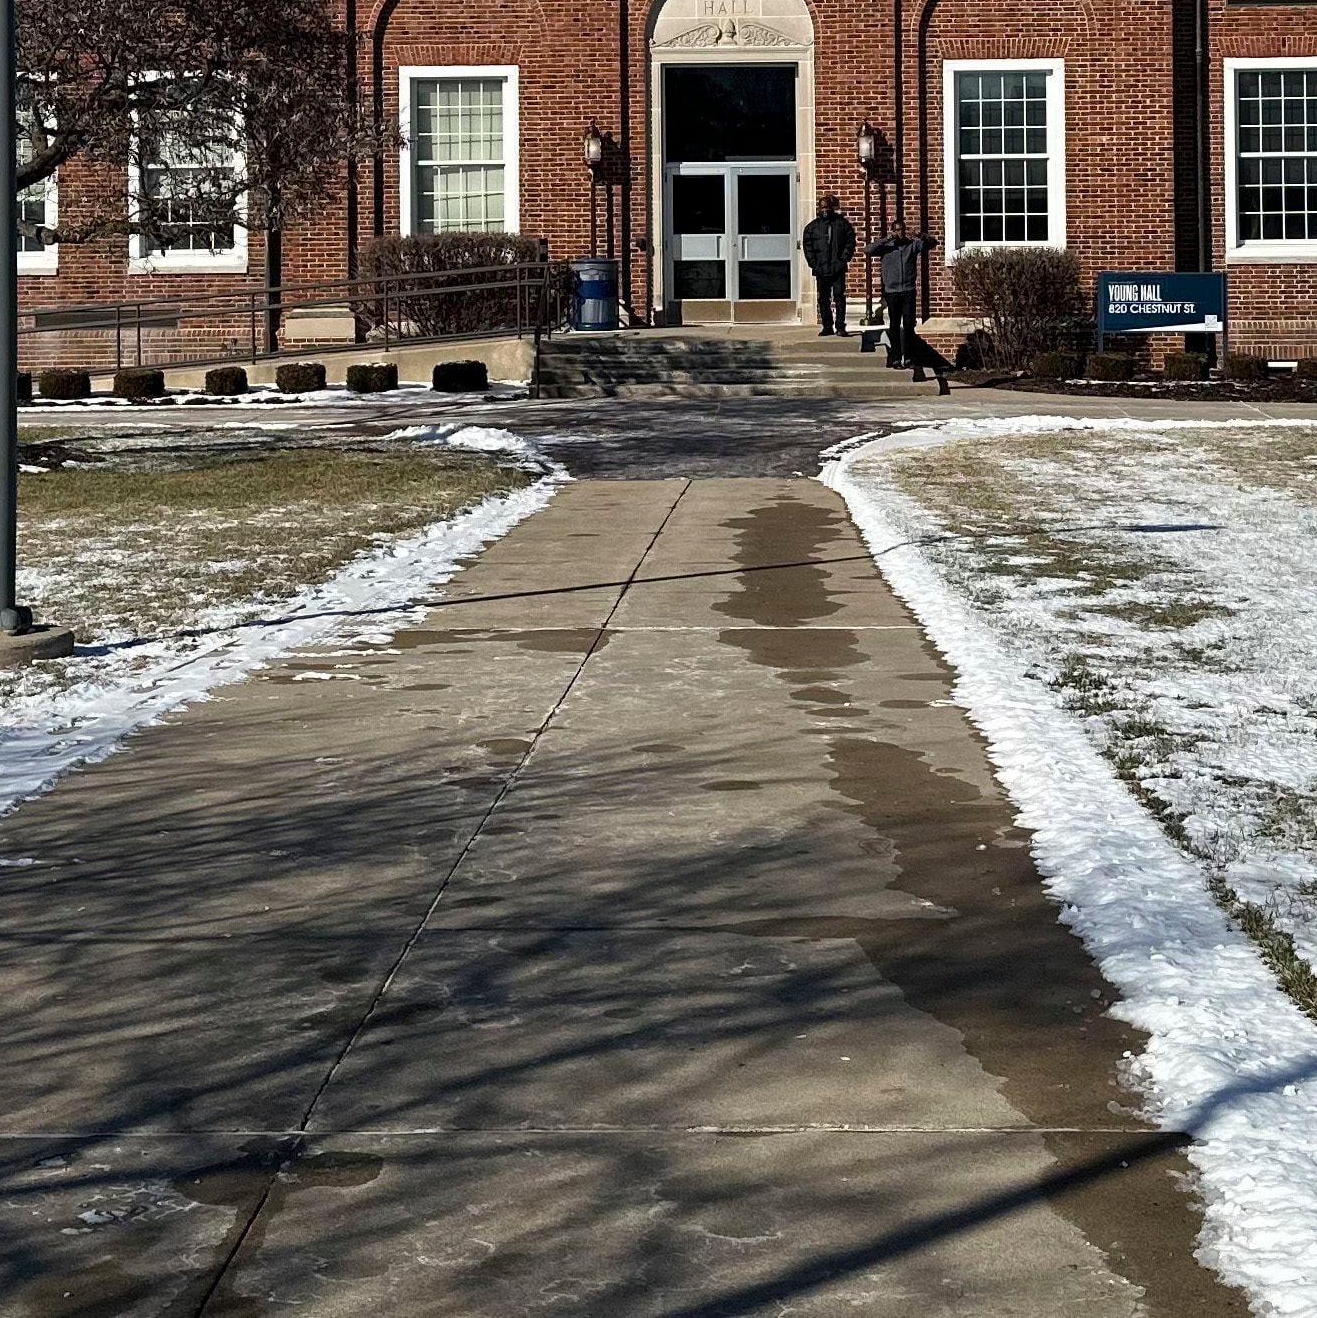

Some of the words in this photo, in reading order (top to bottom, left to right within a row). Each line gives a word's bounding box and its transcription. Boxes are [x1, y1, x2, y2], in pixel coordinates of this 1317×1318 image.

[704, 0, 754, 15] HALL
[1108, 284, 1139, 301] YOUNG
[1140, 284, 1162, 301] HALL
[1108, 303, 1128, 313] 820
[1129, 303, 1181, 313] CHESTNUT
[1183, 303, 1196, 313] ST.
